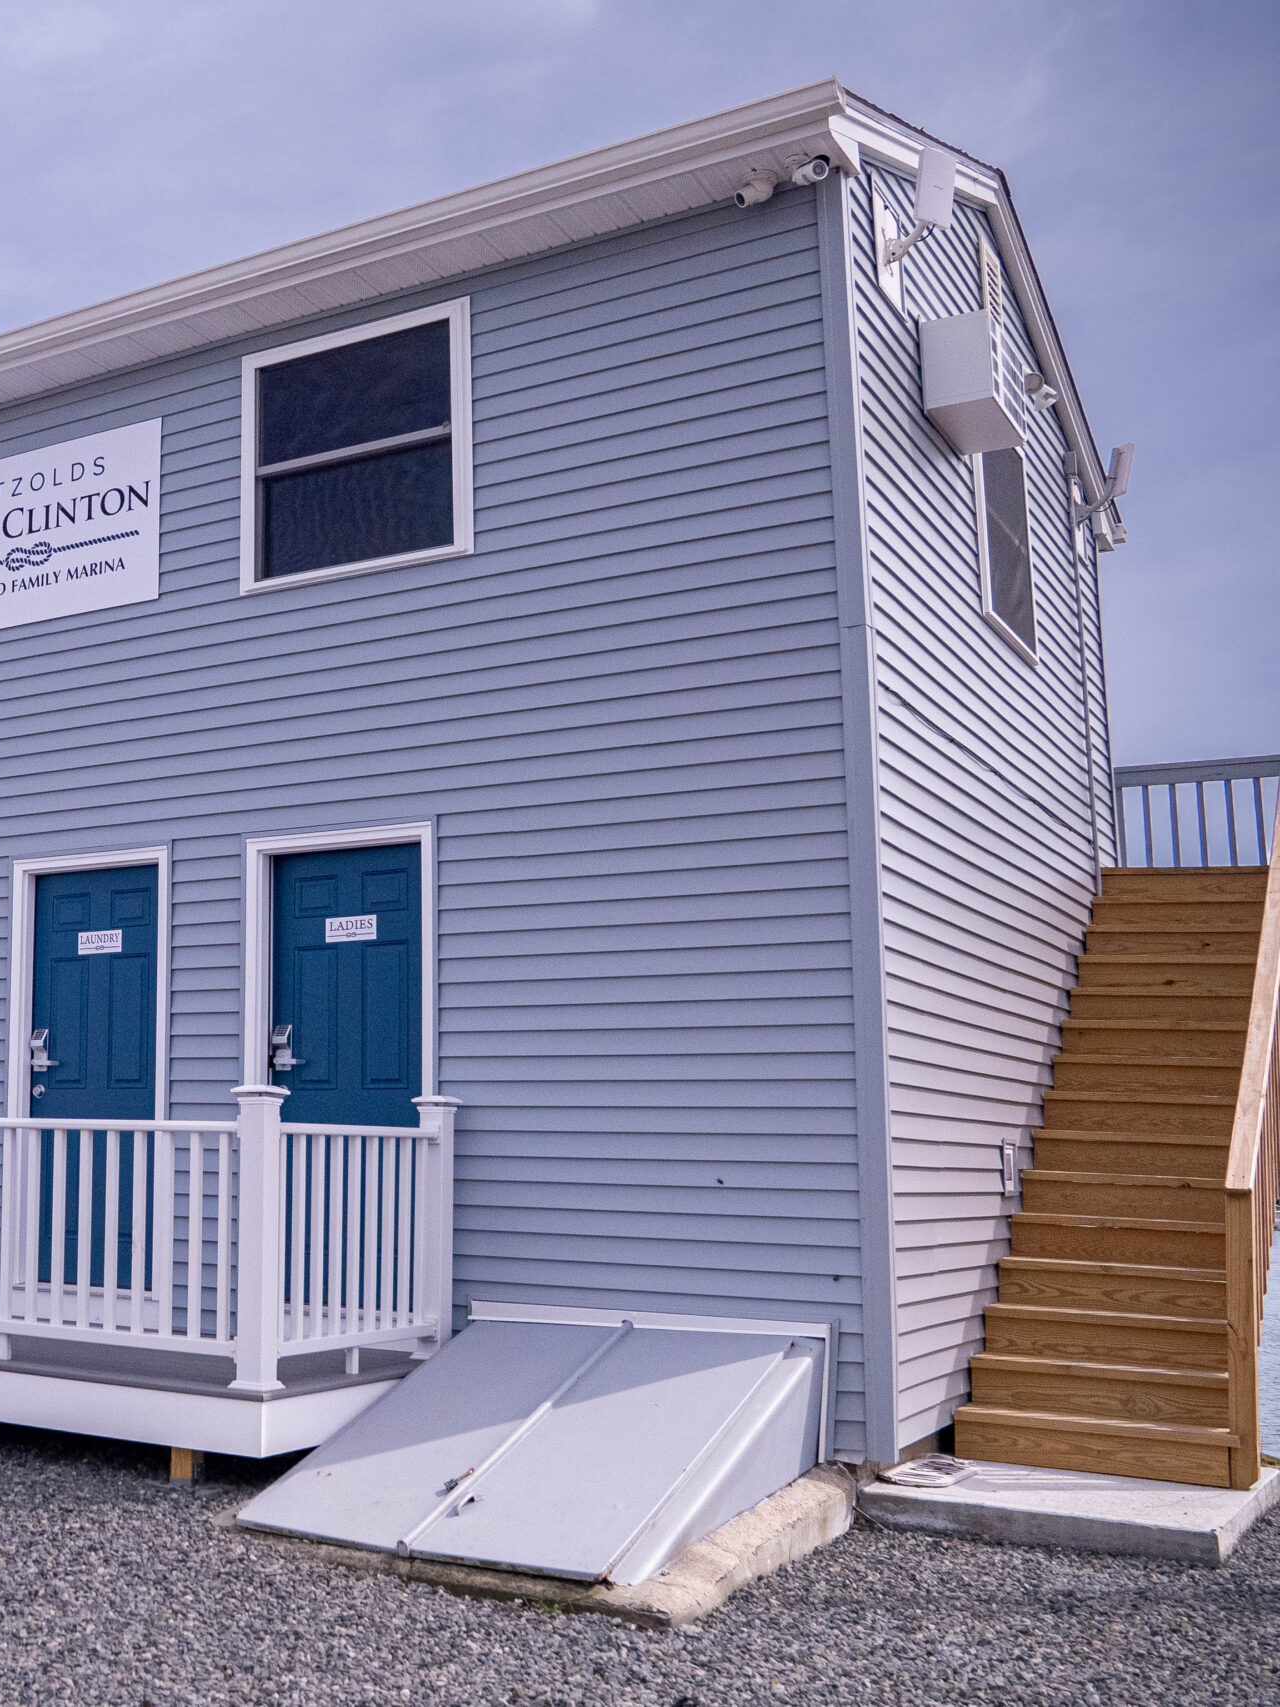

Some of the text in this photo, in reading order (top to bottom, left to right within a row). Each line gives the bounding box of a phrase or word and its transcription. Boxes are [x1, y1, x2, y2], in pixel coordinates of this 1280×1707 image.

[2, 480, 151, 539] CLINTON
[11, 570, 62, 593] FAMILY
[66, 557, 126, 581] MARINA
[329, 918, 373, 931] LADIES
[80, 933, 120, 945] LAUNDRY
